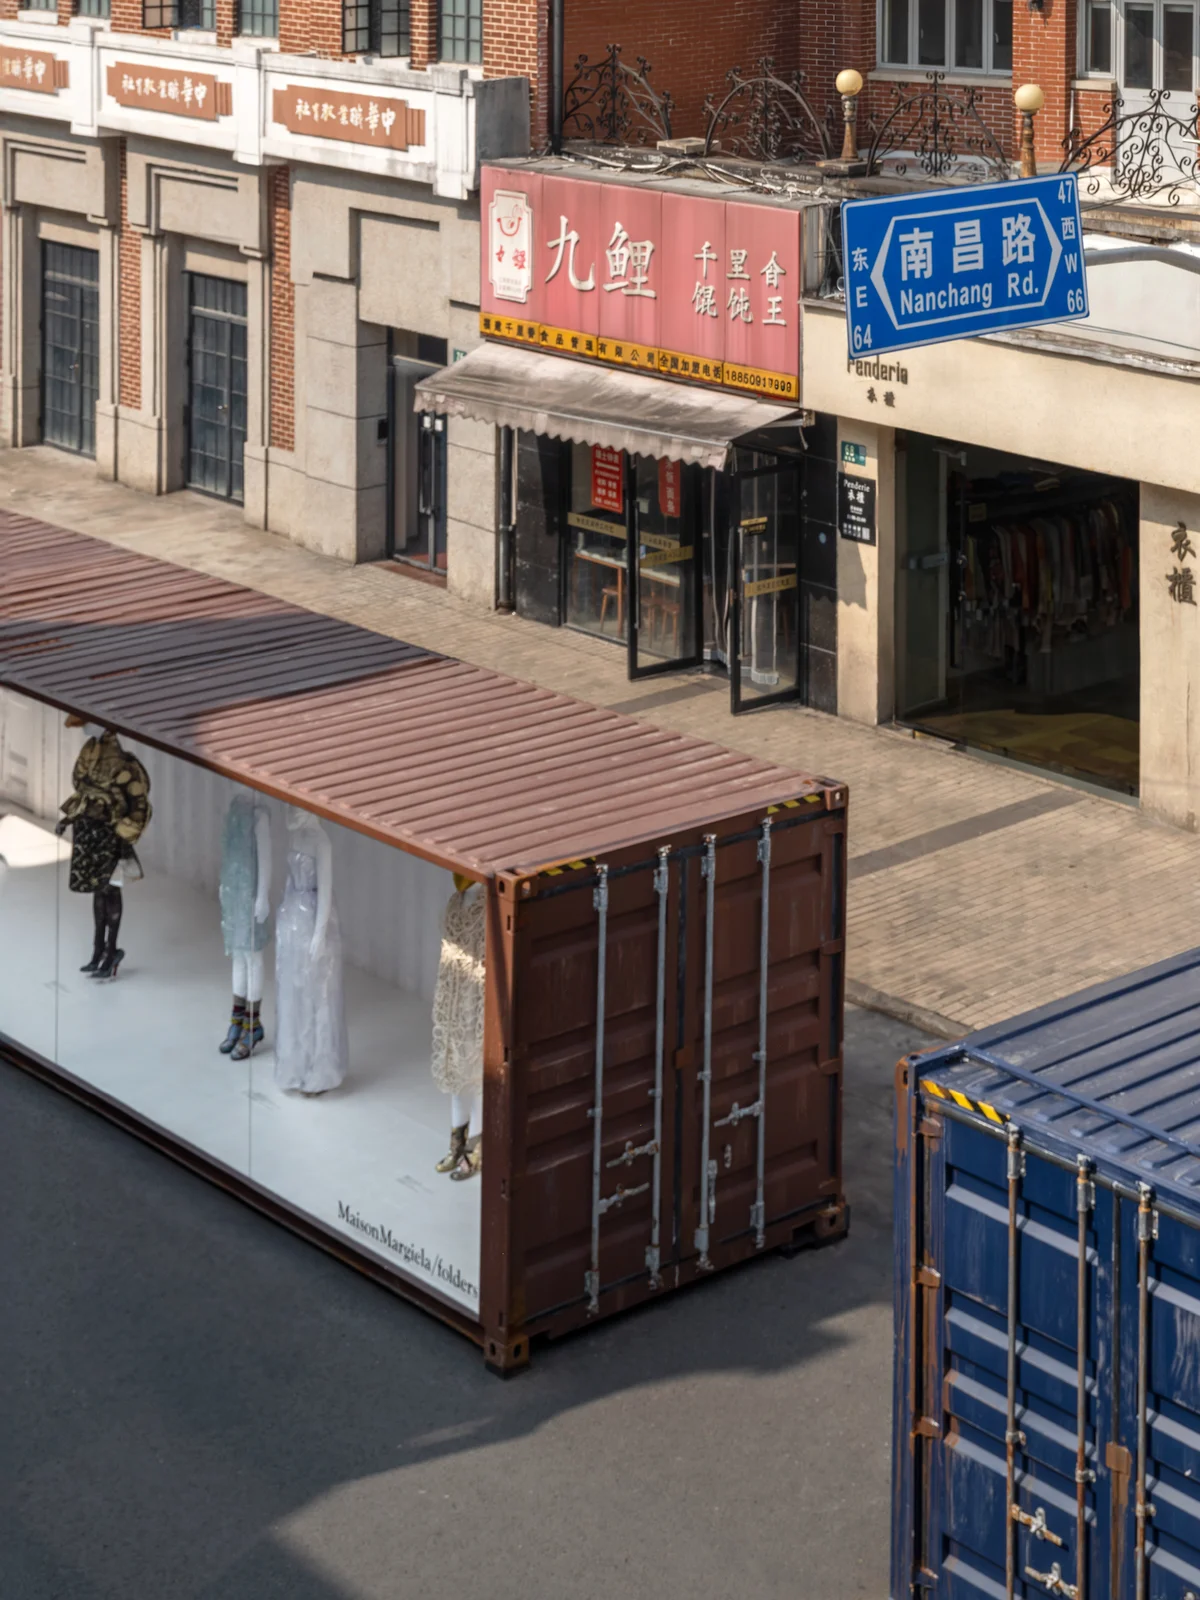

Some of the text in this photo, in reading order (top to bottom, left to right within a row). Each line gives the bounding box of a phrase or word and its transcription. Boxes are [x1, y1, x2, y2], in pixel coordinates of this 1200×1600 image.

[1058, 180, 1074, 205] 47
[1061, 216, 1076, 241] 西
[545, 215, 657, 299] 九鲤
[852, 247, 869, 272] 东
[899, 213, 1036, 282] 南昌路
[1064, 252, 1078, 275] W
[692, 281, 787, 327] 馄饨王
[856, 285, 868, 308] E
[900, 270, 1039, 316] Nanchang Rd.
[1067, 289, 1084, 313] 66
[853, 323, 872, 350] 64
